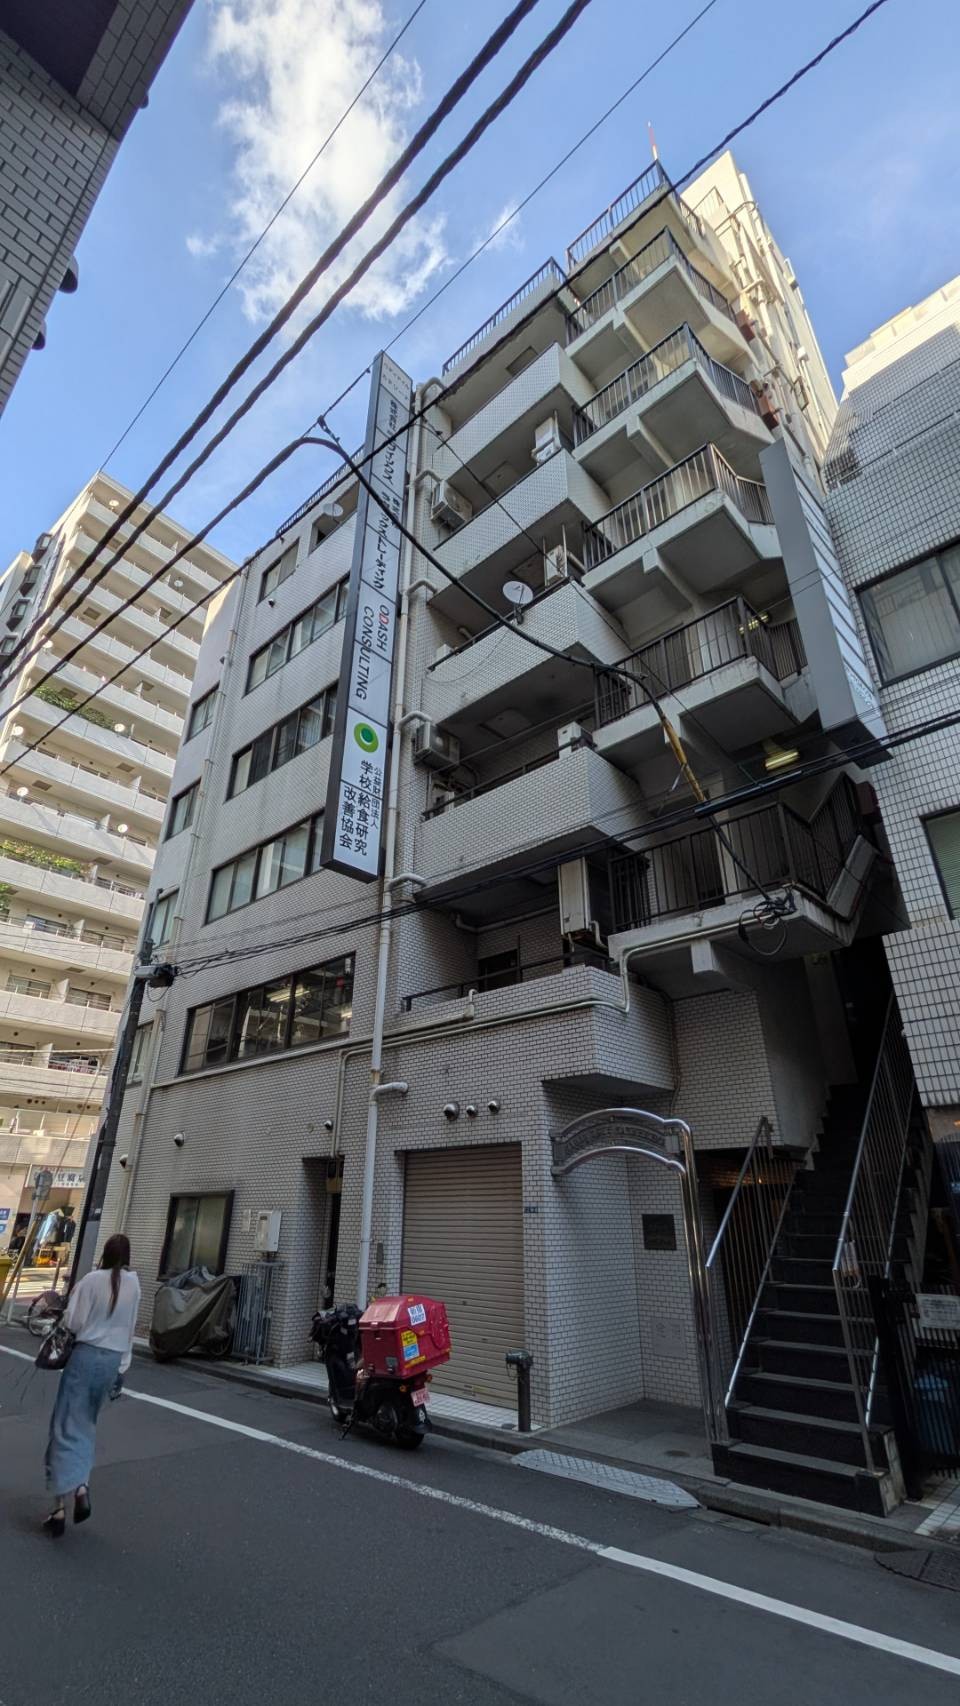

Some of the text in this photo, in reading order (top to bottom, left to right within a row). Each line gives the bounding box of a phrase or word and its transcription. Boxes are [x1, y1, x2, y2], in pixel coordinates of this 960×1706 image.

[356, 606, 374, 700] CONSULTING
[376, 604, 390, 652] ODASH
[340, 785, 356, 850] 改善協会
[354, 760, 373, 856] 学校給食研究
[370, 767, 382, 830] 公益財団法人
